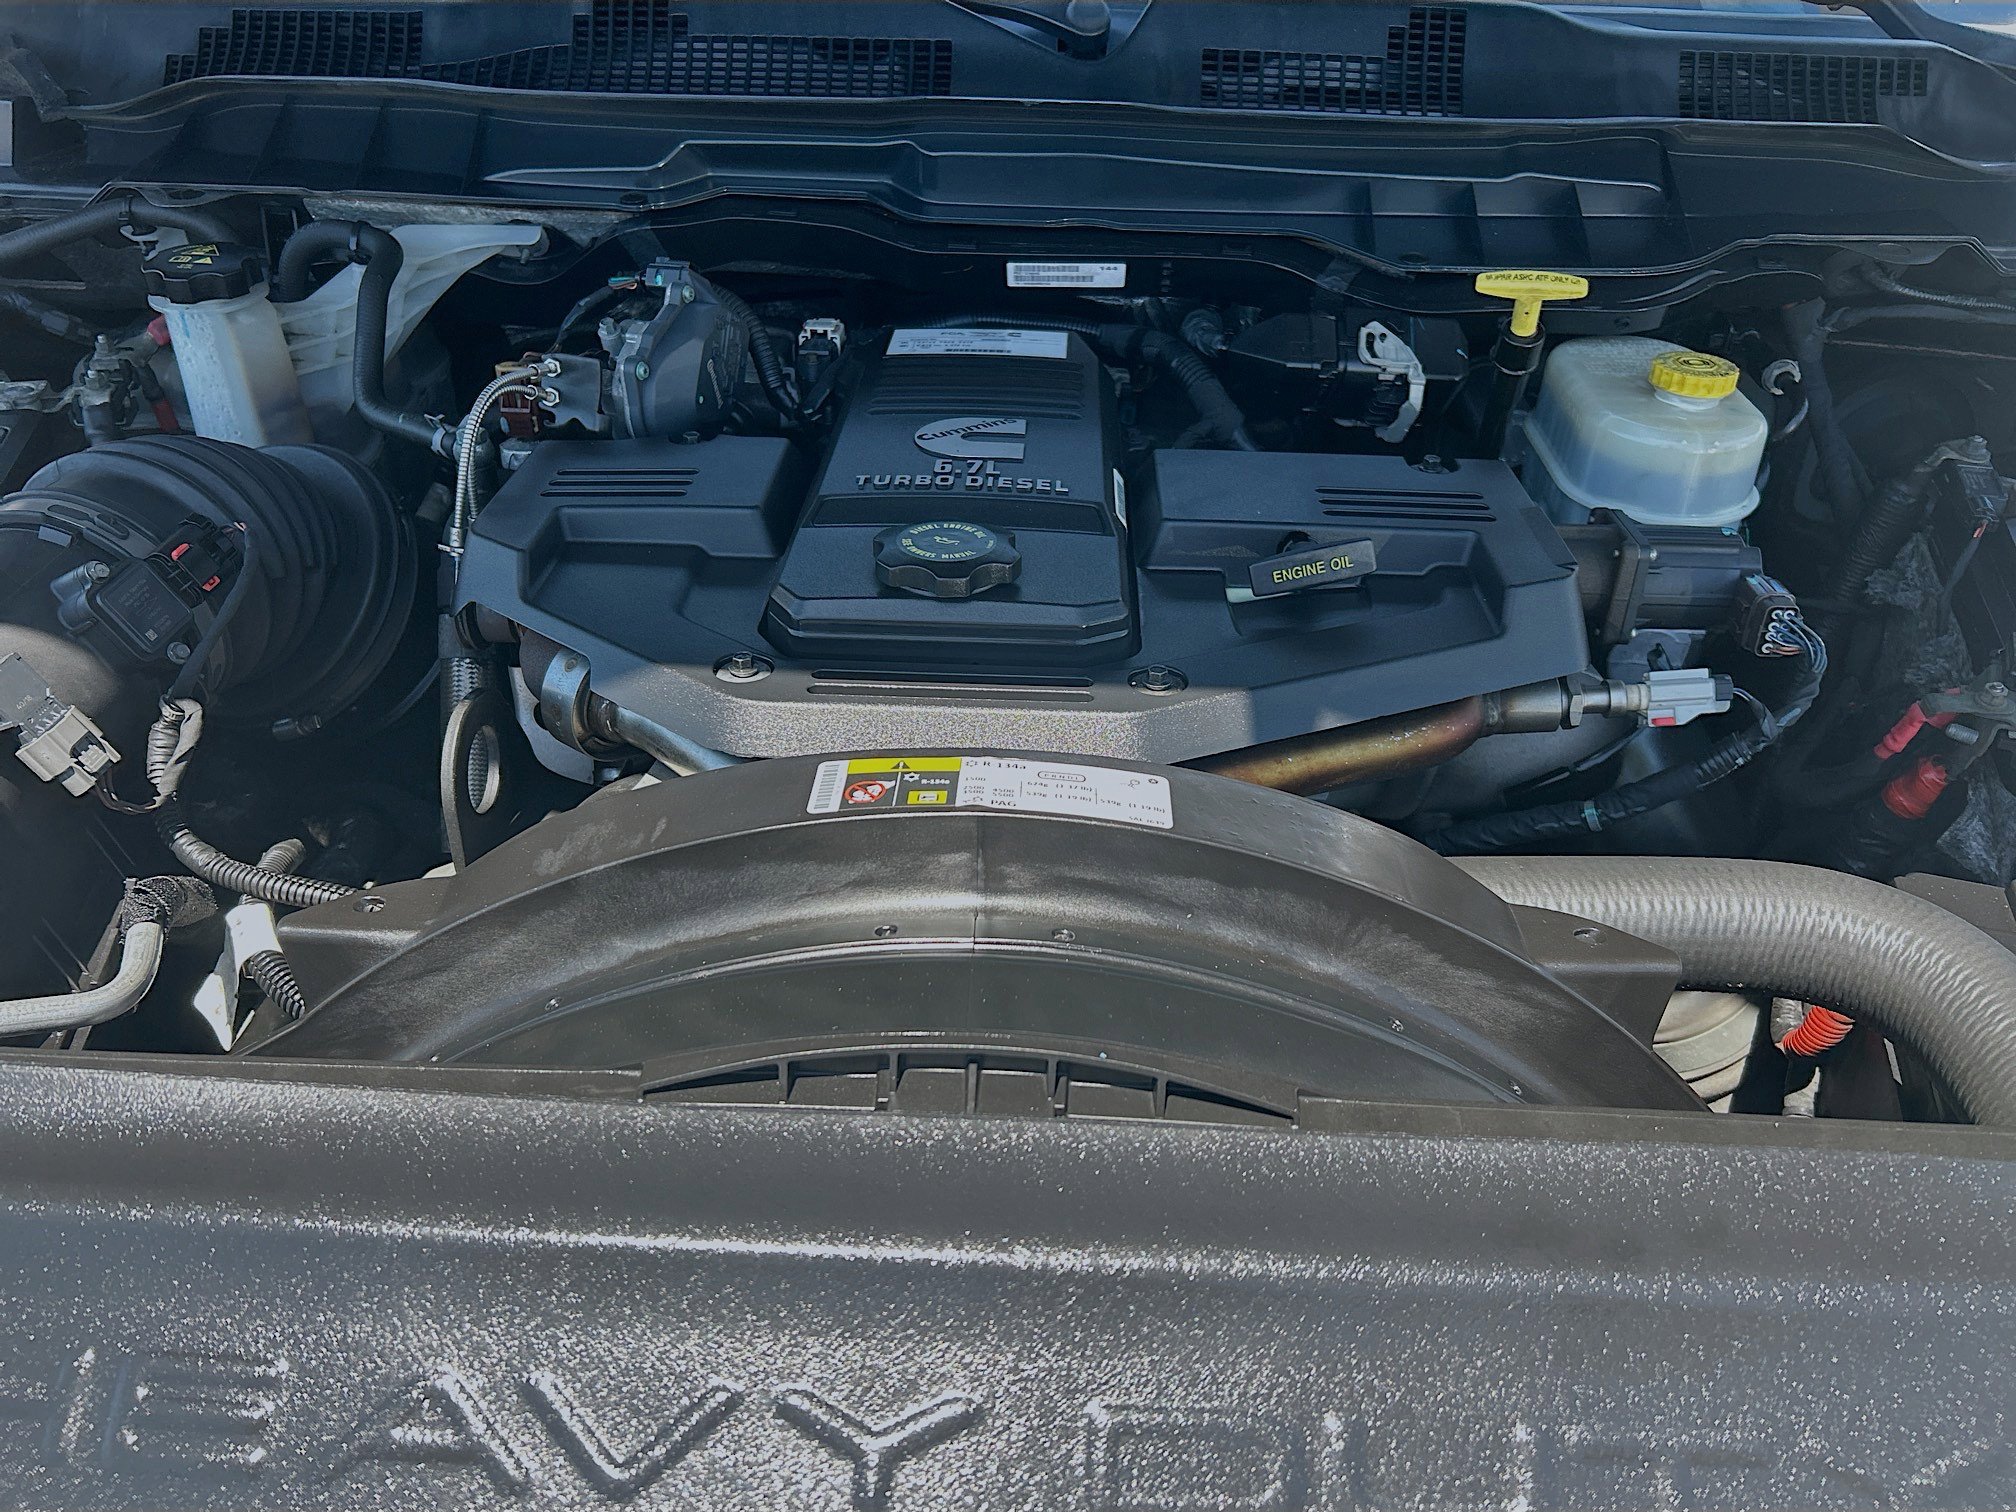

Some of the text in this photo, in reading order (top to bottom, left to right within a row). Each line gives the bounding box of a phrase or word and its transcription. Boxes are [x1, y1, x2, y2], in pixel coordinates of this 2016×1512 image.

[916, 418, 1016, 441] Cummins
[933, 459, 1001, 476] 6.7L
[856, 473, 1069, 493] TURBO DIESEL
[909, 523, 940, 535] DIESEL
[943, 523, 977, 533] ENGINE
[941, 549, 977, 560] MANUAL
[1272, 555, 1354, 583] ENGINE OIL
[990, 799, 1017, 807] PAG
